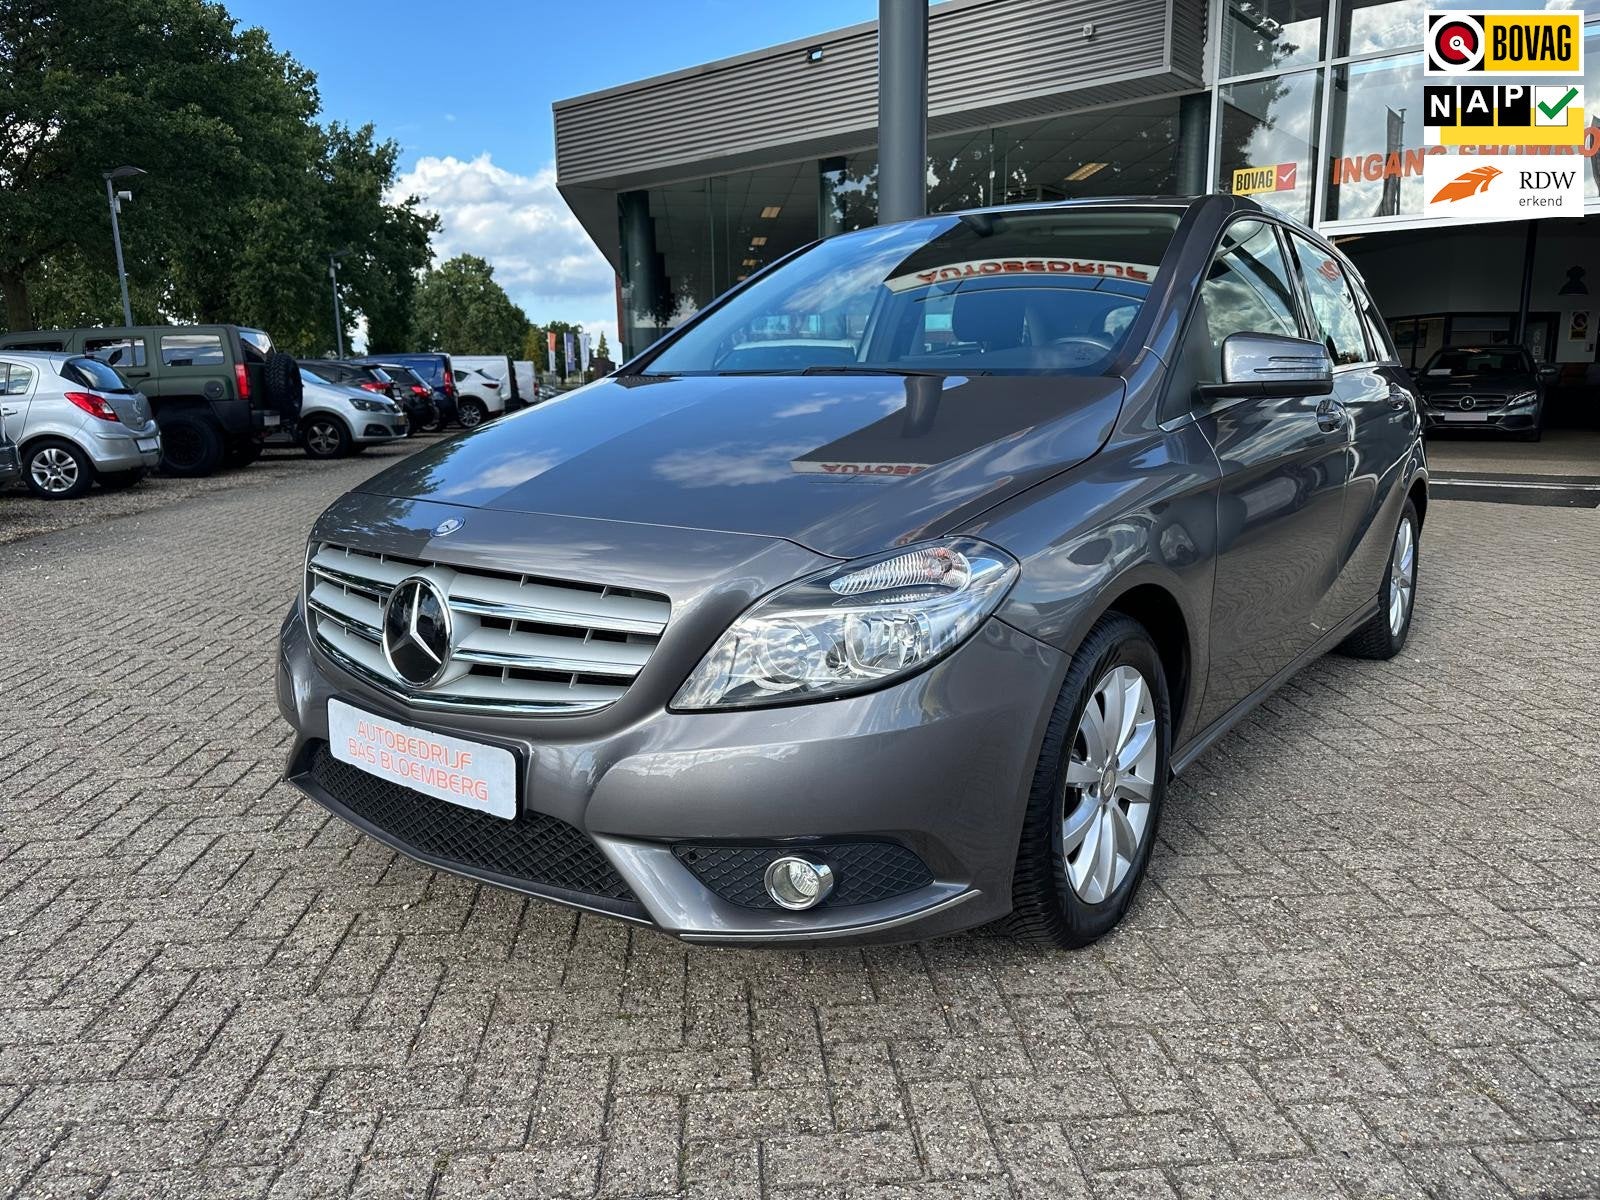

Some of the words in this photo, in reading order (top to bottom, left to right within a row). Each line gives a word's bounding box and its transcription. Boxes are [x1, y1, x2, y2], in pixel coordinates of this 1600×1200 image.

[1236, 170, 1273, 191] BOVAG
[348, 736, 376, 764] BAS
[380, 751, 489, 801] BLOEMBERG
[357, 720, 473, 770] AUTOBEDRIJF
